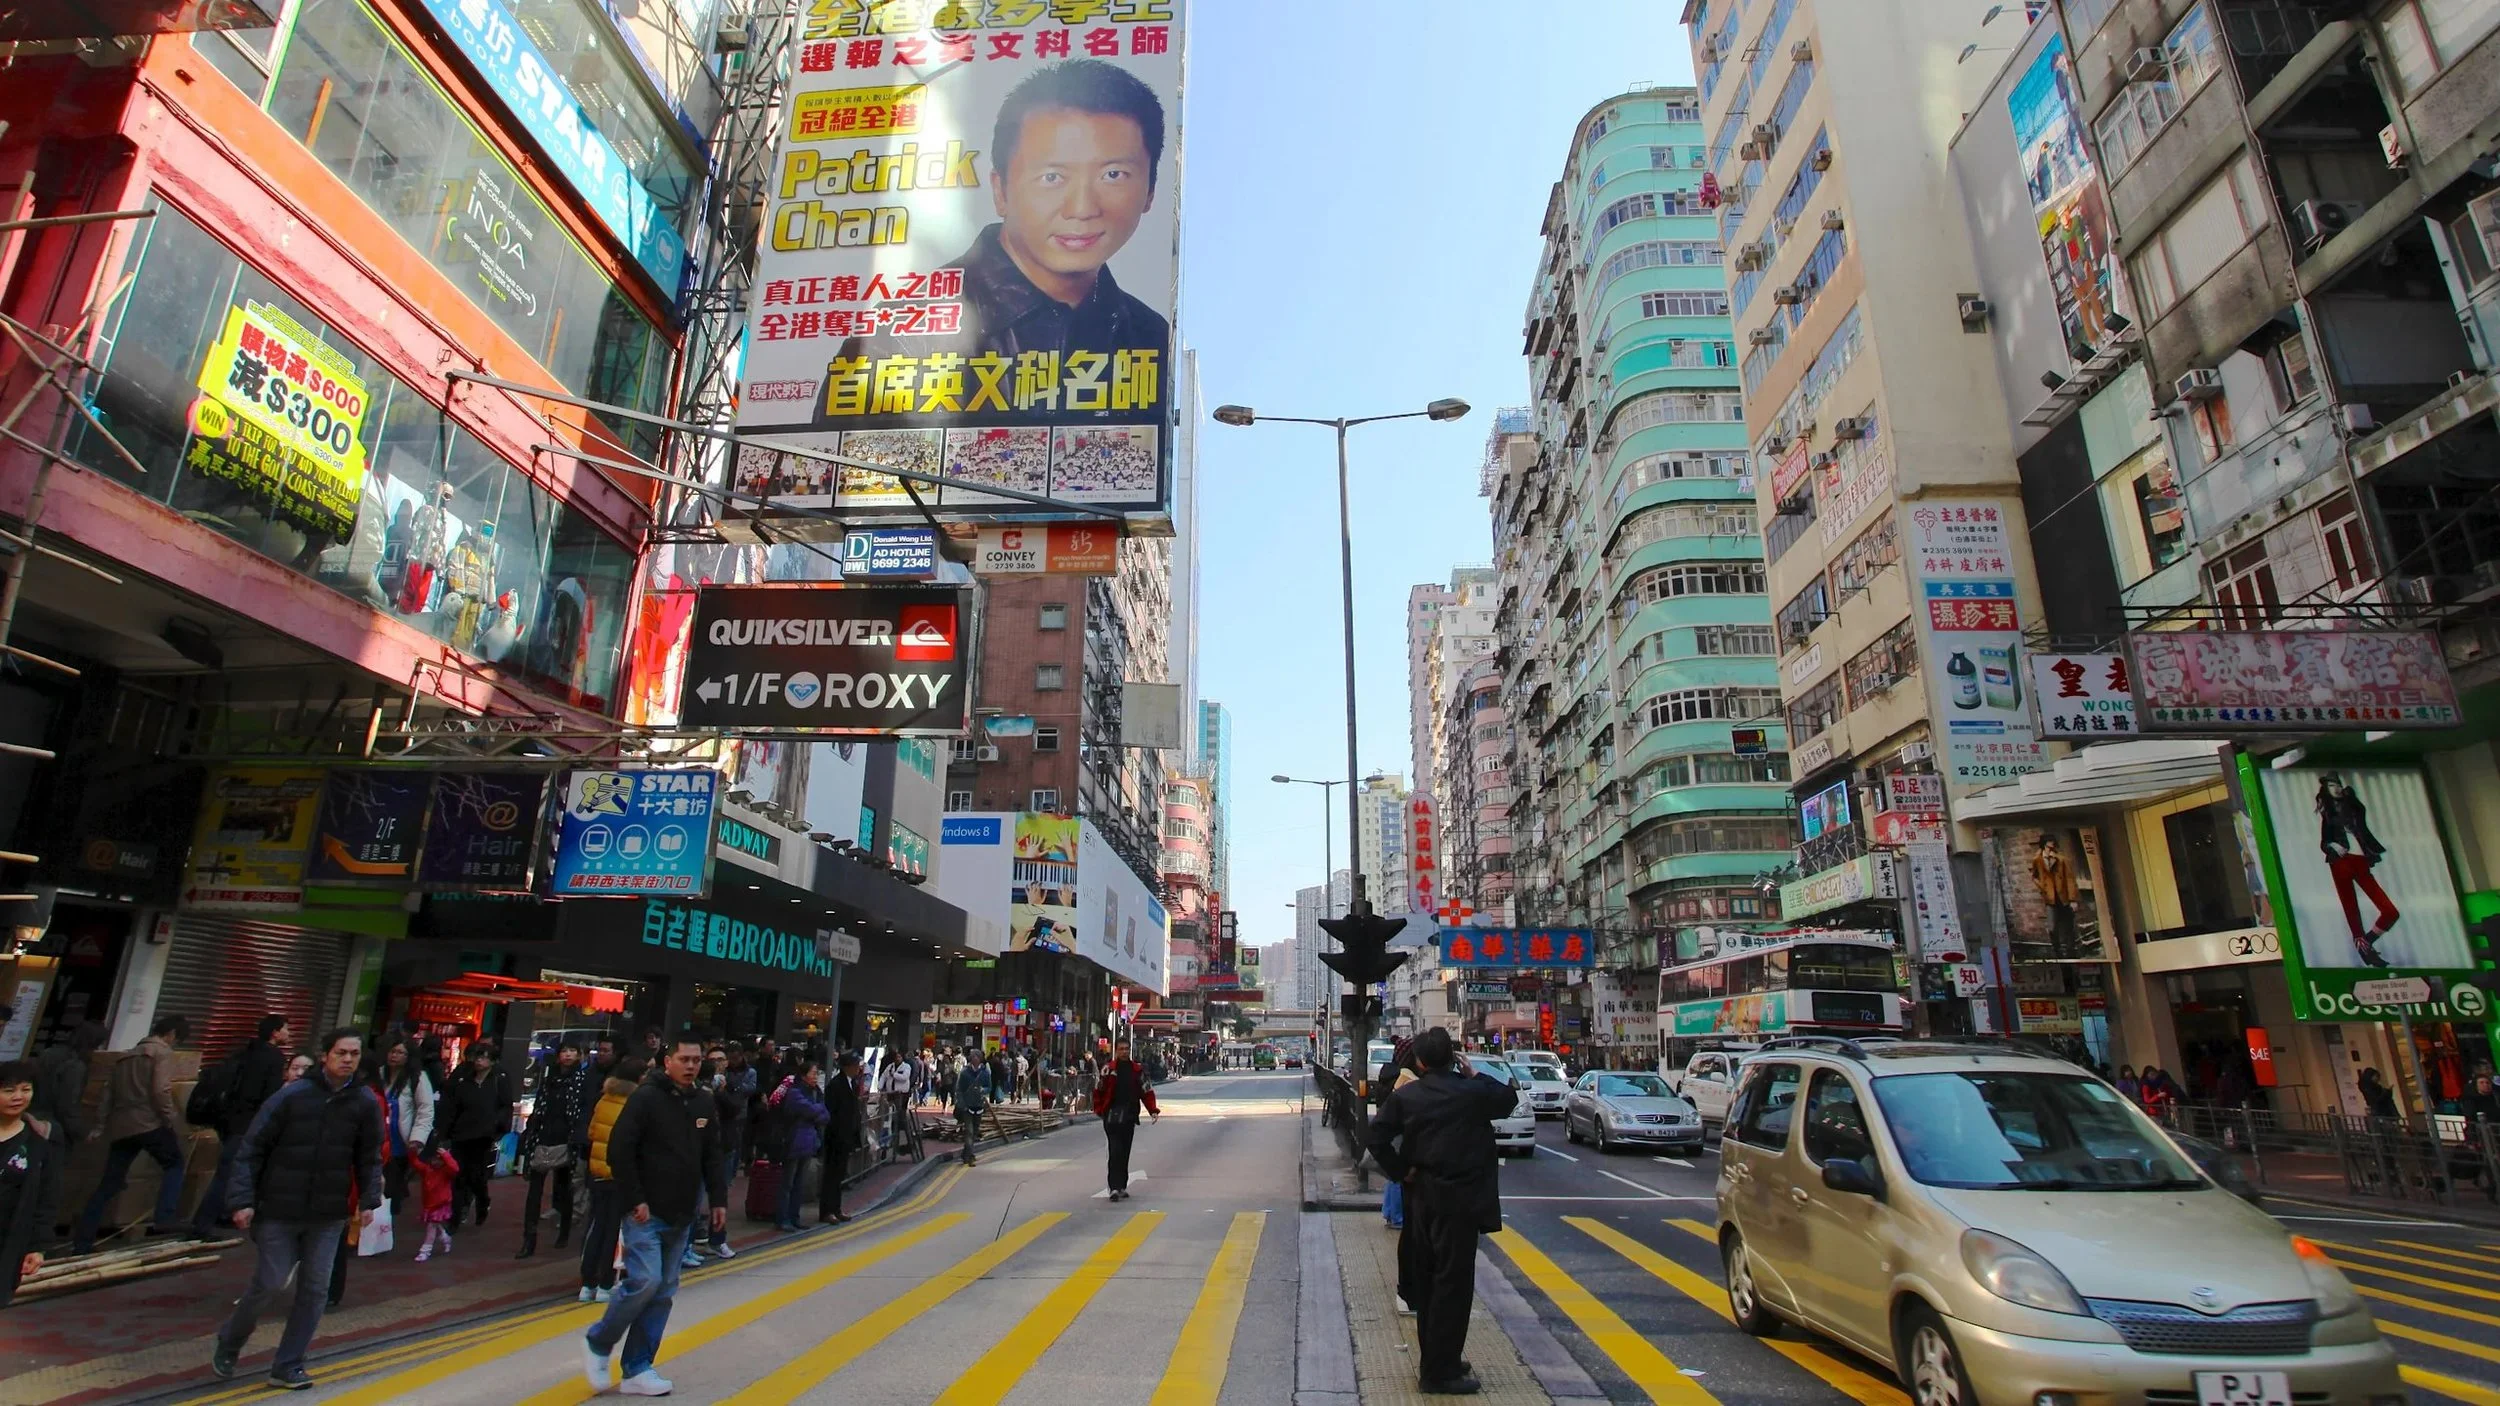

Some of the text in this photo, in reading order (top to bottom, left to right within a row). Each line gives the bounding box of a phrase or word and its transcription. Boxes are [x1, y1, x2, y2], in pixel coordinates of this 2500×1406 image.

[799, 25, 1169, 73] 選報之英文科名師
[515, 50, 607, 184] STAR
[799, 103, 917, 135] 冠絕全港
[779, 141, 980, 199] Patrick
[771, 200, 909, 252] Chan
[762, 268, 963, 306] 真正萬人之師
[239, 322, 362, 418] 購物滿$600
[748, 380, 818, 401] 現代教育
[826, 349, 1159, 417] 首席英文科名師
[229, 349, 352, 456] 減$300
[201, 404, 225, 432] WIN
[240, 443, 262, 471] THE
[873, 534, 934, 545] Donald Wong Ltd.
[1930, 547, 1951, 555] 2395
[872, 557, 931, 569] 9699 2348
[873, 547, 931, 558] AD HOTLINE
[986, 551, 1036, 562] CONVEY
[843, 559, 868, 573] DWL
[1932, 601, 2014, 629] 濕疹清
[708, 618, 893, 646] QUIKSILVER
[725, 673, 782, 706] 1/F
[824, 673, 952, 709] ROXY
[640, 775, 710, 793] STAR
[1971, 766, 2007, 777] 2518
[1891, 778, 1921, 794] 知足
[638, 798, 707, 816] 十大書坊
[376, 817, 397, 840] 2/F
[719, 819, 771, 859] ADWAY
[983, 826, 991, 837] 8
[466, 835, 524, 857] Hair
[568, 874, 692, 889] 請用西洋菜街入口
[1483, 984, 1507, 994] YONEX
[2249, 1047, 2271, 1062] SALE
[2221, 1374, 2265, 1401] PJ
